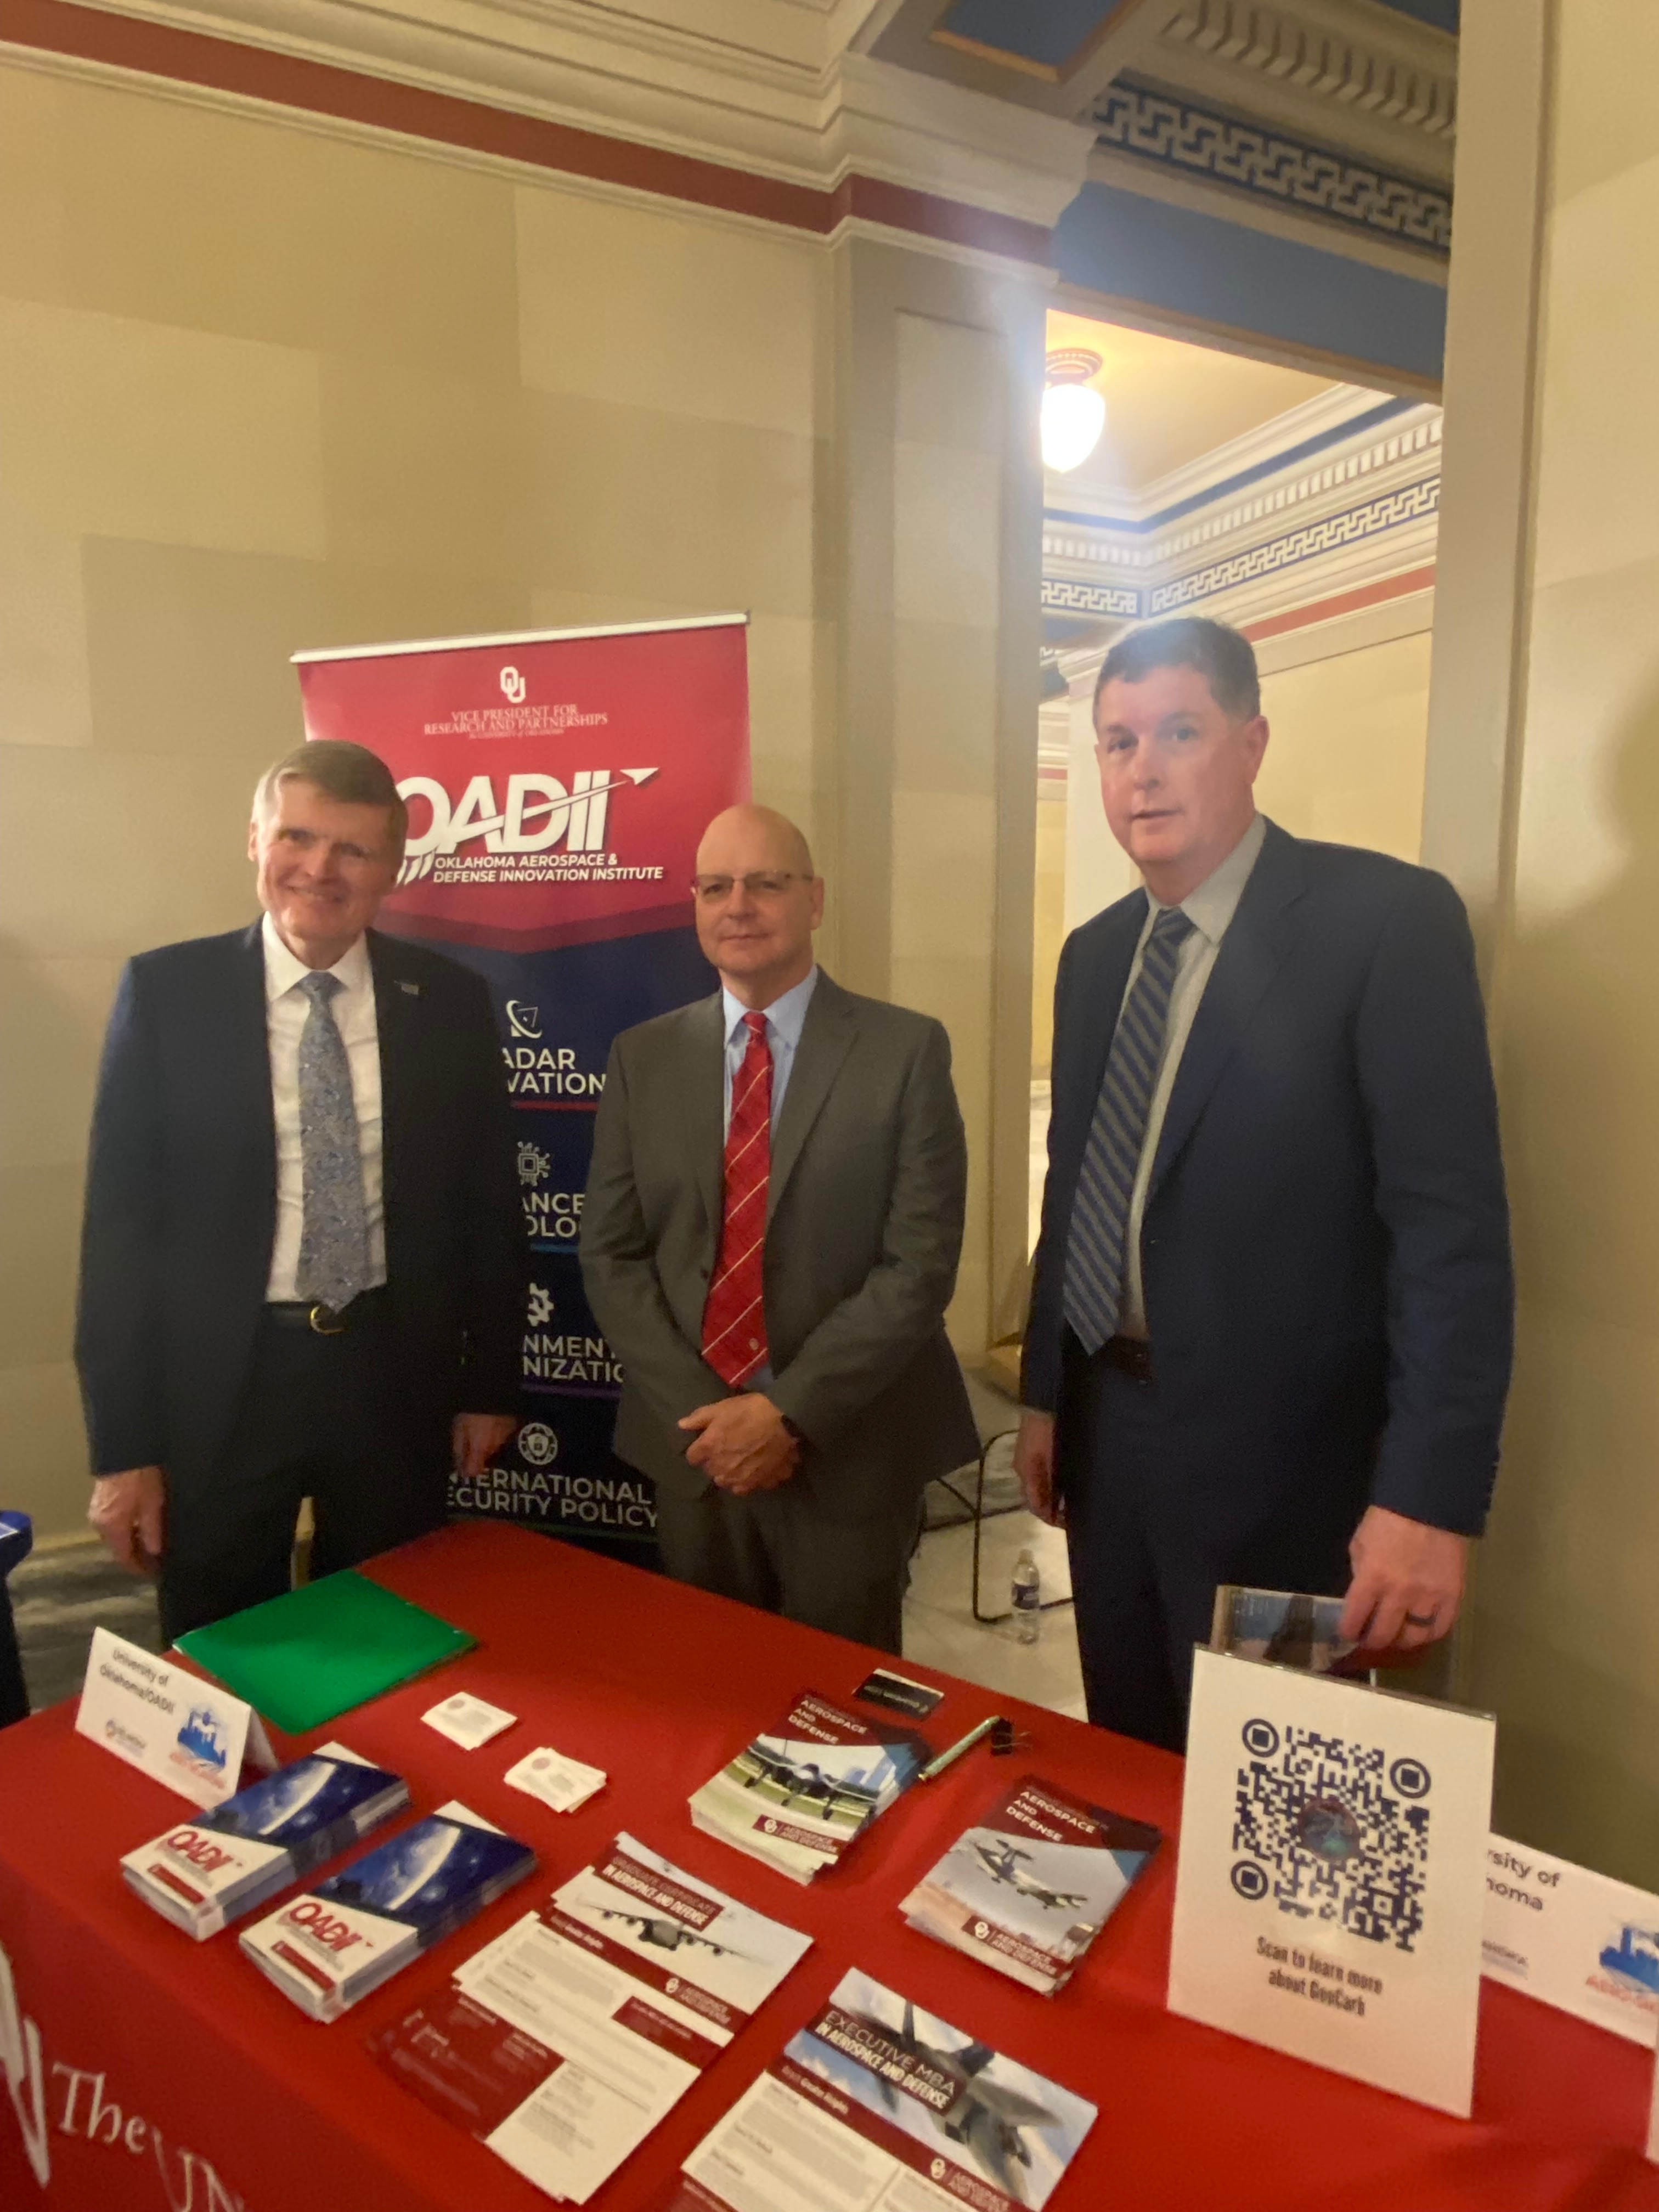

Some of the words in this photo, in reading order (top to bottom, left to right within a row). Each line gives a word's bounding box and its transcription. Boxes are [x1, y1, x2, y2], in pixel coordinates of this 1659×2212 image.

[424, 721, 484, 735] RESEARCH
[489, 719, 515, 731] AND
[518, 713, 608, 729] PARTNERSHIPS
[451, 711, 479, 723] VICE
[483, 705, 549, 719] PRESIDENT
[553, 704, 578, 715] FOR
[433, 871, 496, 883] DEFENSE
[499, 868, 589, 883] INNOVATION
[592, 866, 663, 881] INSTITUTE
[435, 856, 515, 869] OKLAHOMA
[519, 854, 605, 867] AEROSPACE
[608, 854, 617, 865] &
[561, 1498, 657, 1528] POLICY
[788, 1714, 839, 1744] DEFENSE
[793, 1708, 816, 1722] AND
[801, 1700, 867, 1734] AEROSPACE
[1014, 1799, 1037, 1815] AND
[1020, 1791, 1096, 1833] AEROSPACE
[1006, 1806, 1062, 1841] DEFENSE
[1538, 1871, 1561, 1887] of
[1256, 1935, 1288, 1962] Scan
[1292, 1948, 1305, 1969] to
[1308, 1952, 1344, 1980] learn
[1347, 1970, 1383, 1994] more
[1269, 1968, 1306, 1995] about
[825, 2010, 915, 2070] EXECUTIVE
[915, 2063, 955, 2096] MBA
[827, 2029, 884, 2069] AEROSPACE
[879, 2061, 905, 2081] AND
[902, 2074, 951, 2109] DEFENSE
[52, 2061, 147, 2154] The
